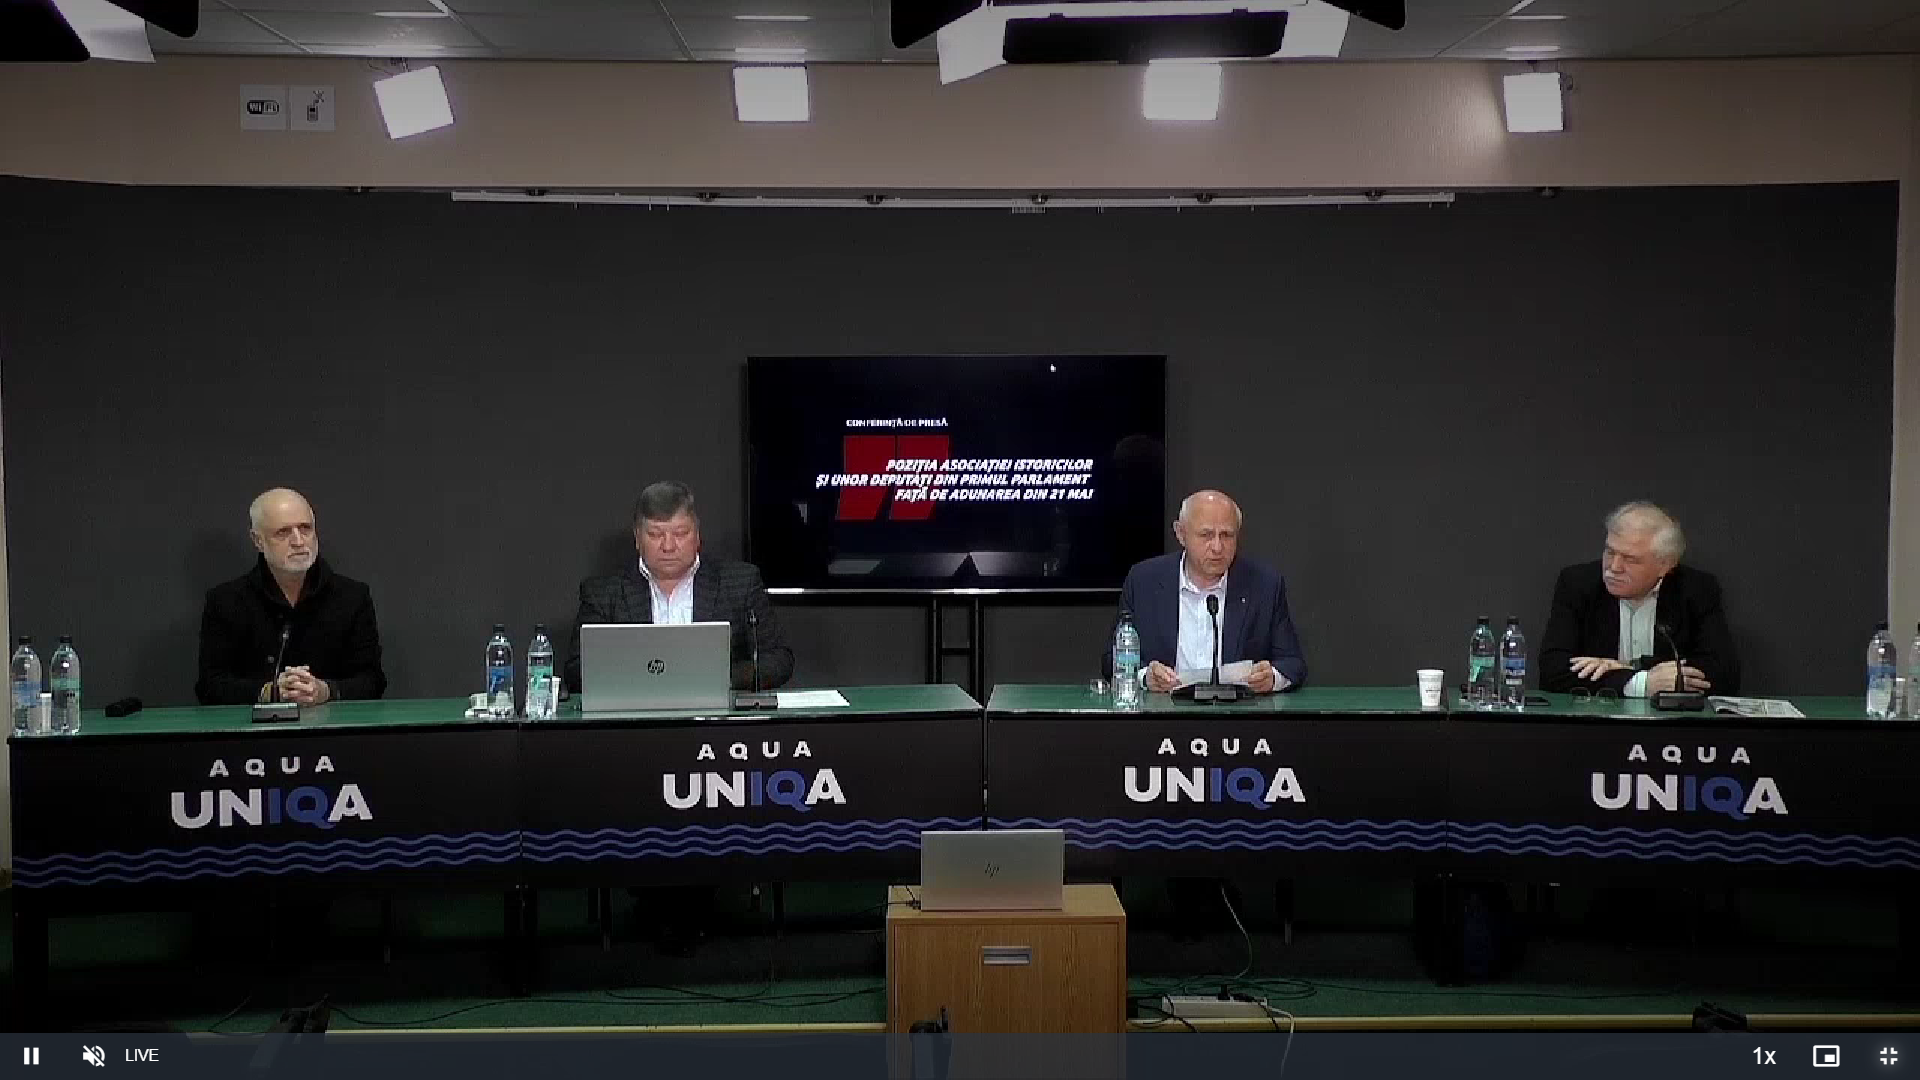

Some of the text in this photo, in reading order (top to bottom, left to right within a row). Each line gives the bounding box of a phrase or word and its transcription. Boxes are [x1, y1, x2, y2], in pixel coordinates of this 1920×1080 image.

[1014, 459, 1093, 471] ISTORICILOR
[831, 474, 868, 486] UNOR
[934, 474, 959, 486] DIN
[960, 474, 1008, 486] PRIMUL
[1011, 474, 1092, 486] PARLAMENT
[930, 489, 949, 501] DE
[949, 489, 1021, 501] ADUNAREA
[1023, 489, 1048, 500] DIN
[1049, 489, 1065, 500] 21
[1066, 489, 1093, 500] MAI
[696, 740, 812, 761] AQUA
[1158, 738, 1272, 757] AQUA
[1627, 744, 1751, 764] AQUA
[209, 755, 335, 778] AQUA
[662, 768, 847, 812] UNIQA
[1124, 766, 1306, 810] UNIQA
[1591, 772, 1789, 820] UNIQA
[171, 783, 373, 829] UNIQA
